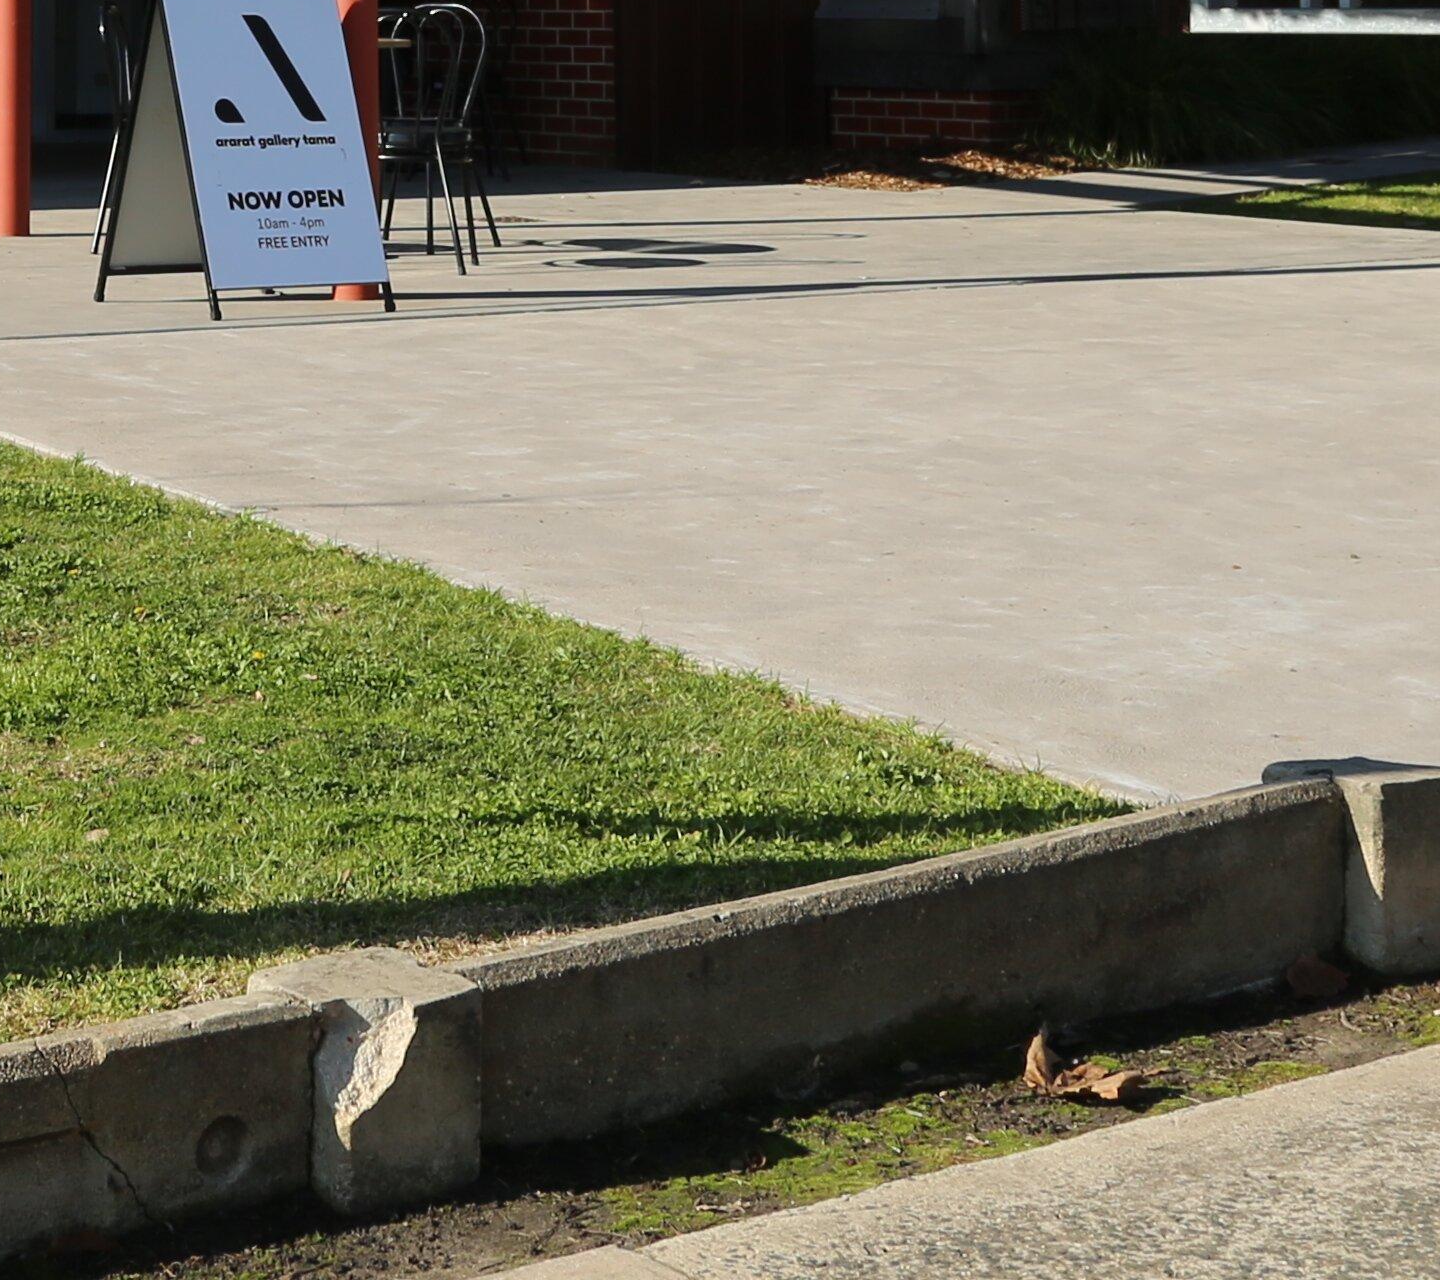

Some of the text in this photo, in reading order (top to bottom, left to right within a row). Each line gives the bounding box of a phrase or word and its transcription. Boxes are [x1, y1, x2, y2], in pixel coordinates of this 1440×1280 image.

[215, 134, 336, 150] ararat gallery tama
[227, 189, 345, 210] NOW OPEN
[257, 218, 290, 230] 10am
[300, 216, 325, 230] 4pm
[257, 235, 330, 249] FREE ENTRY
